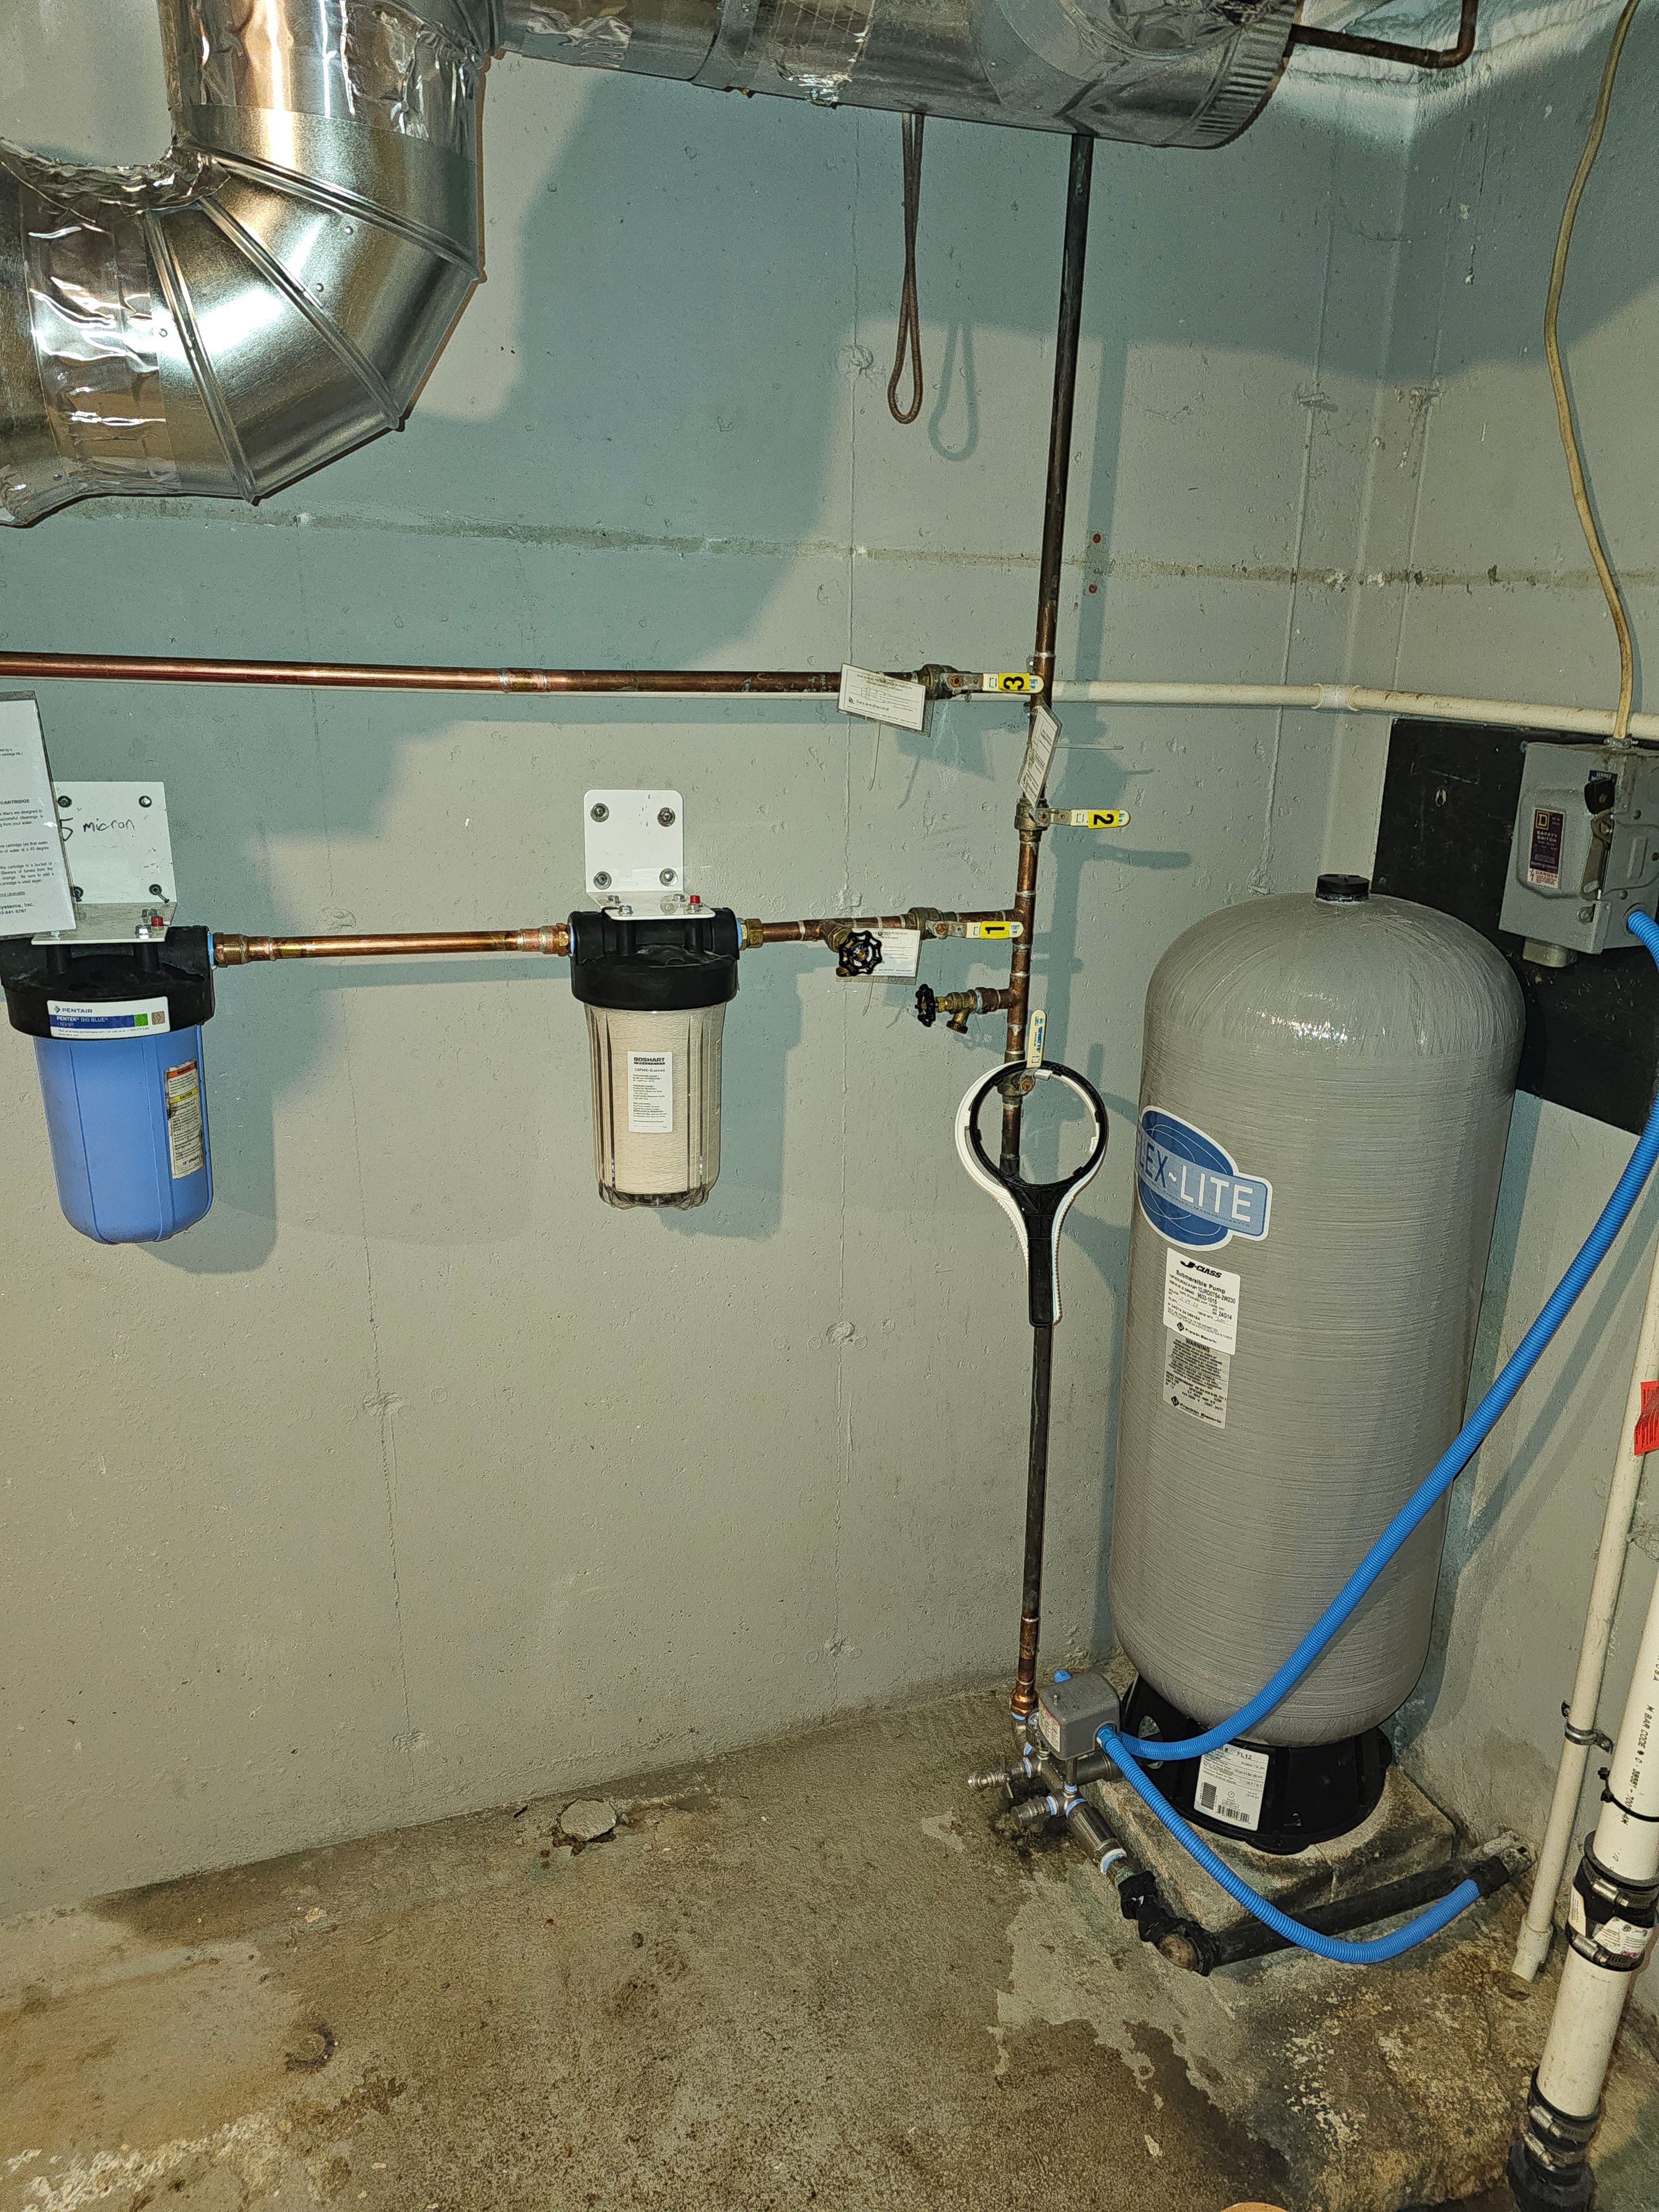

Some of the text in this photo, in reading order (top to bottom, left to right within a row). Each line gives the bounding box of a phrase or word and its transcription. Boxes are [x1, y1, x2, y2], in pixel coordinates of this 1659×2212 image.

[1003, 676, 1024, 689] 3
[856, 699, 889, 711] Secondwind
[1093, 814, 1114, 825] 2
[1538, 814, 1547, 826] D
[59, 817, 135, 841] 5 micron
[1537, 830, 1558, 838] SAFETY
[1180, 1261, 1221, 1277] J-CLASS
[1176, 1270, 1206, 1287] Submersible
[1209, 1284, 1225, 1294] Pump
[1218, 1311, 1232, 1319] 24G14
[1185, 1338, 1209, 1352] WARNING
[1642, 1713, 1652, 1729] BAR
[1638, 1729, 1648, 1749] CODE
[1237, 1751, 1252, 1760] FL12
